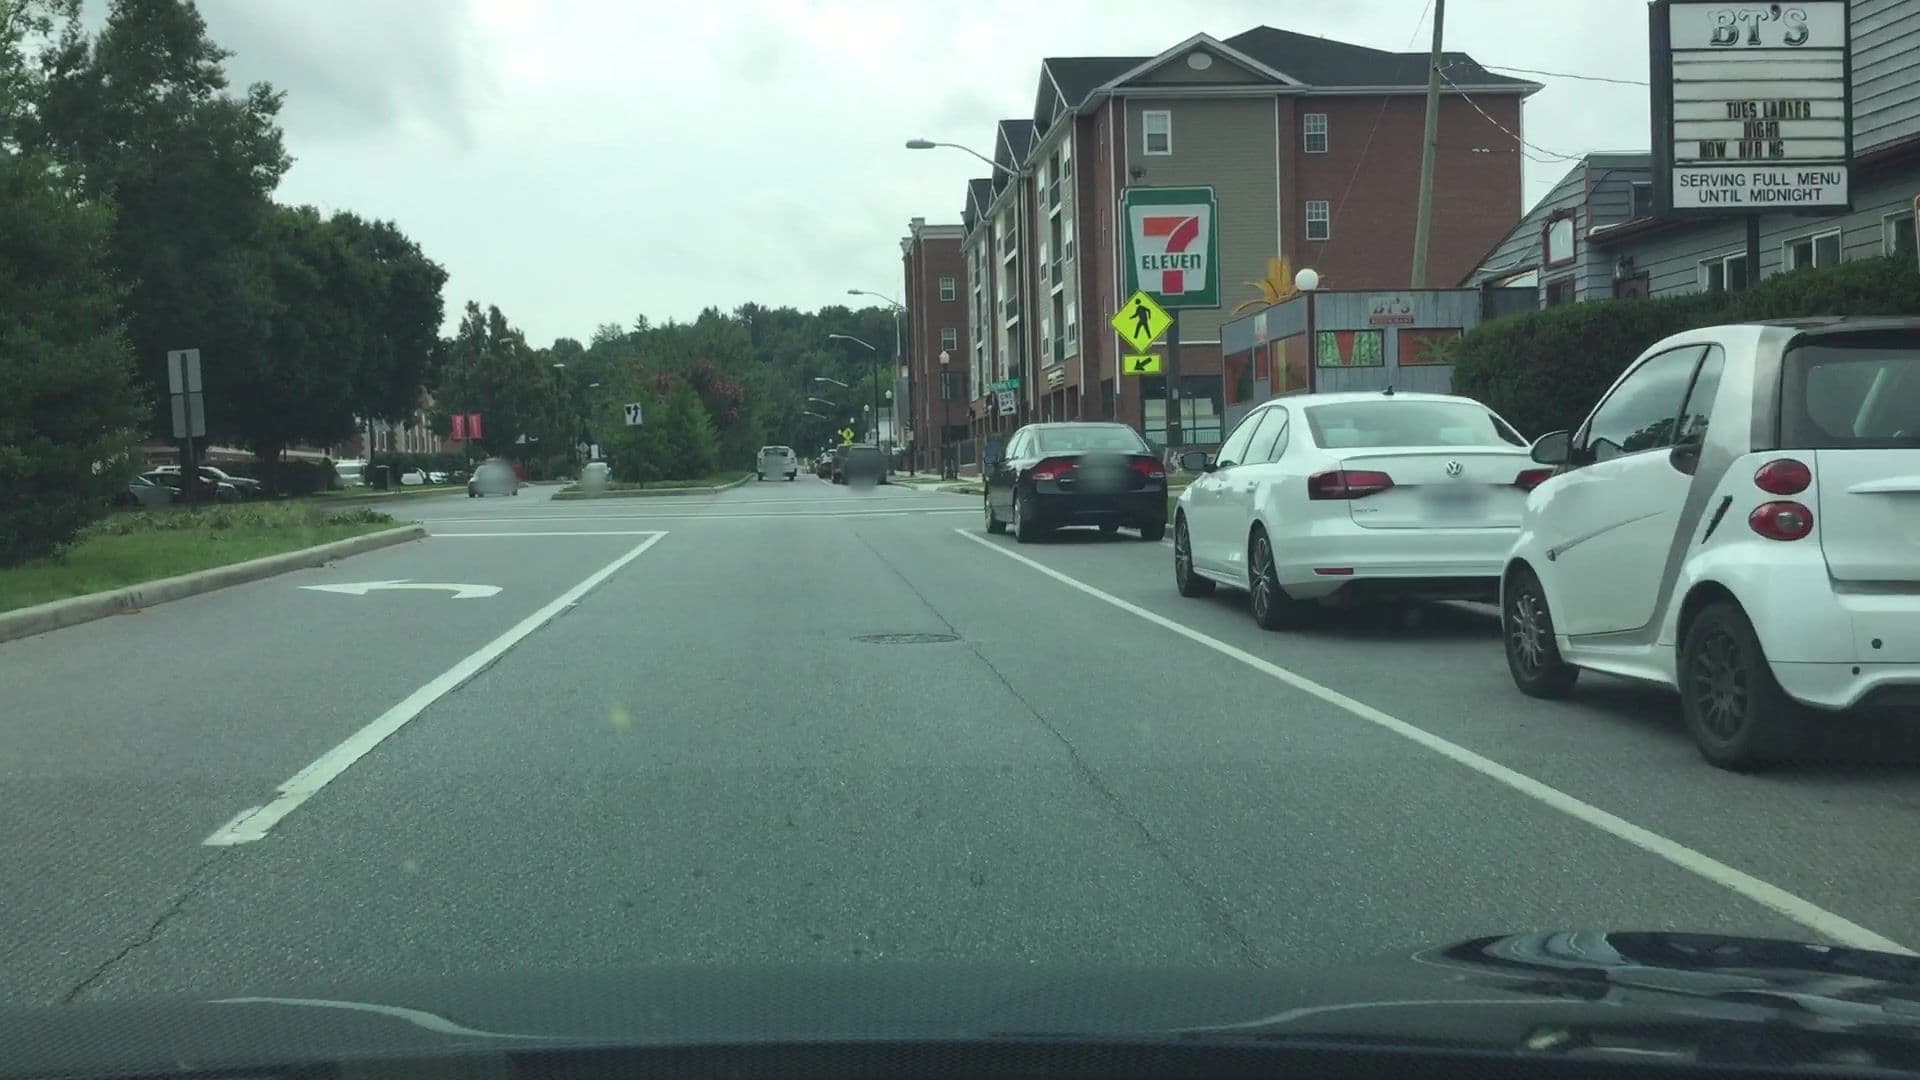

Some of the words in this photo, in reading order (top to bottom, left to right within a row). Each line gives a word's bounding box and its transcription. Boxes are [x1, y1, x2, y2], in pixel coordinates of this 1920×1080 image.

[1707, 4, 1809, 46] BT'S
[1726, 101, 1757, 118] TUES
[1744, 121, 1779, 138] NIGHT
[1700, 141, 1726, 158] NOW
[1680, 174, 1746, 187] SERVING
[1753, 173, 1790, 186] FULL
[1798, 172, 1841, 185] MENU
[1699, 189, 1742, 203] UNTIL
[1750, 188, 1822, 202] MIDNIGHT
[1144, 216, 1199, 293] 7
